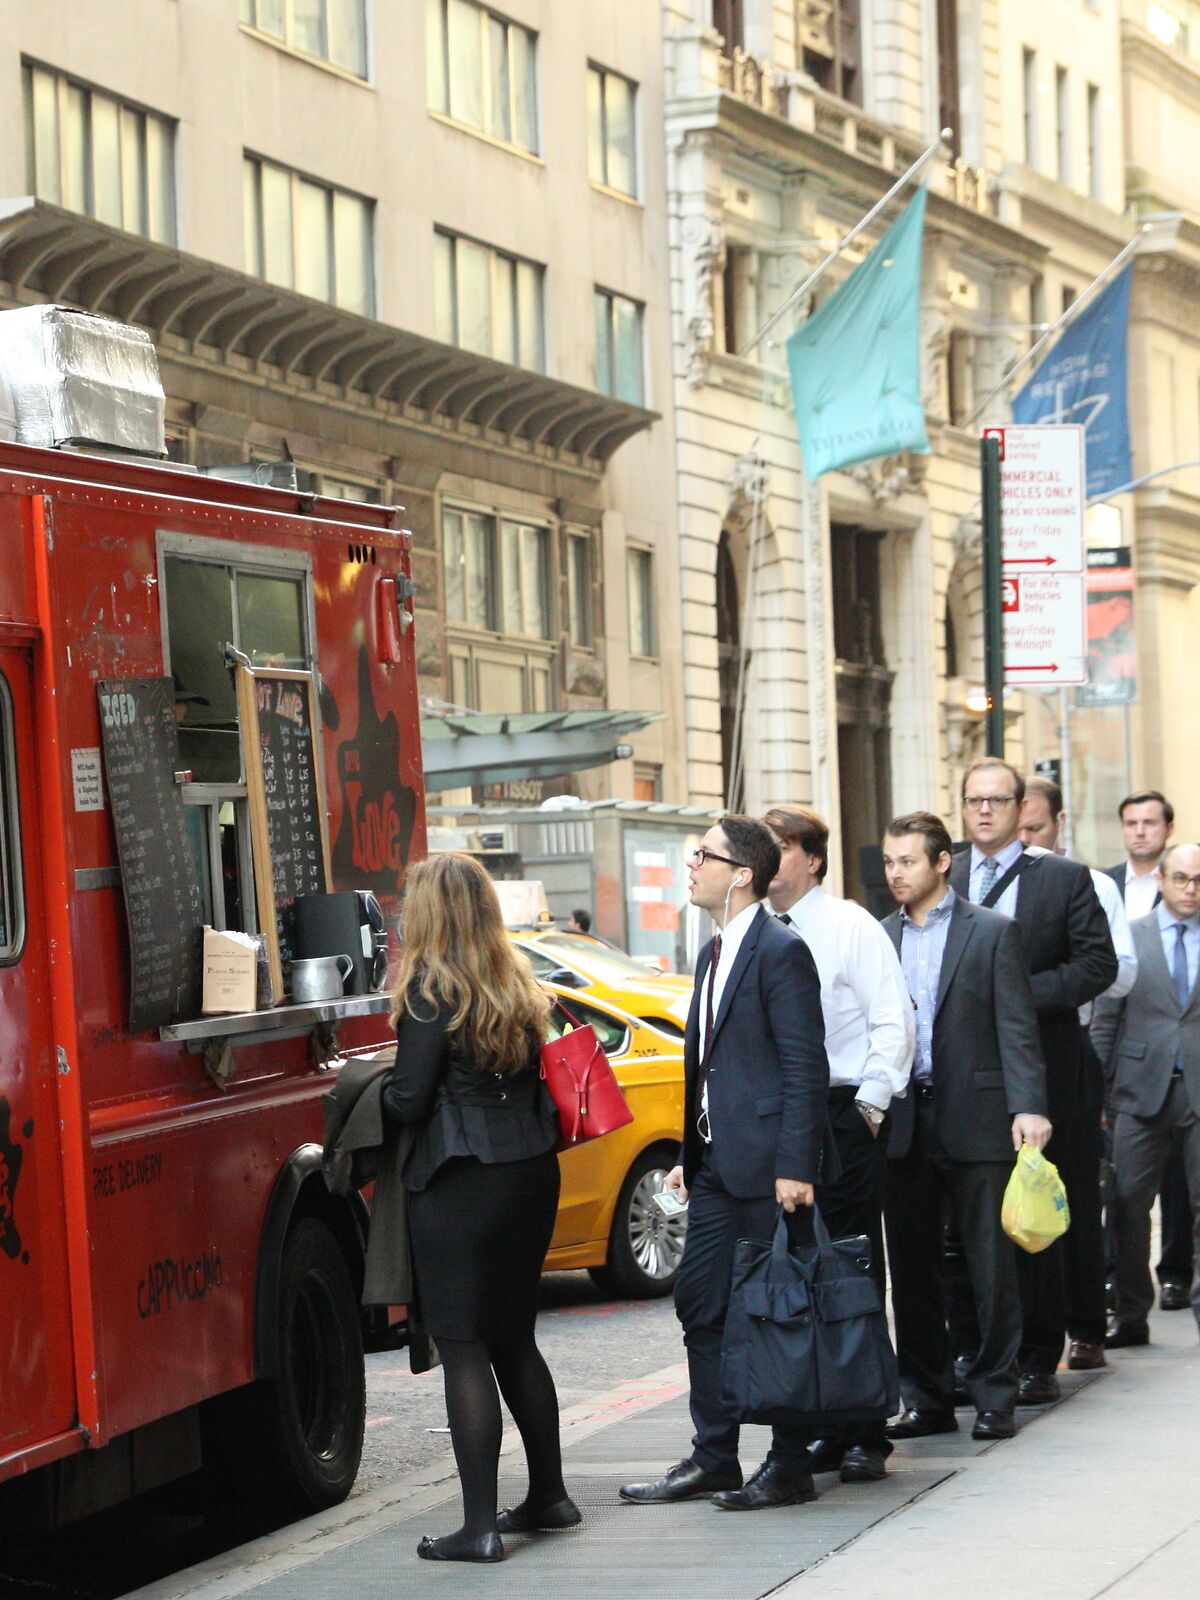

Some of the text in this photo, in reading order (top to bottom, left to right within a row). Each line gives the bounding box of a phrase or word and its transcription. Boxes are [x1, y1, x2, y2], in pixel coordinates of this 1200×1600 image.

[1001, 486, 1073, 499] HICLES ONLY
[1036, 507, 1076, 516] STANDING
[1033, 525, 1062, 536] Friday
[1041, 578, 1059, 588] Hire
[1023, 590, 1062, 600] Vehicles
[1023, 603, 1044, 614] Only
[101, 693, 136, 729] ICED
[92, 1152, 164, 1200] FREE DELIVERY
